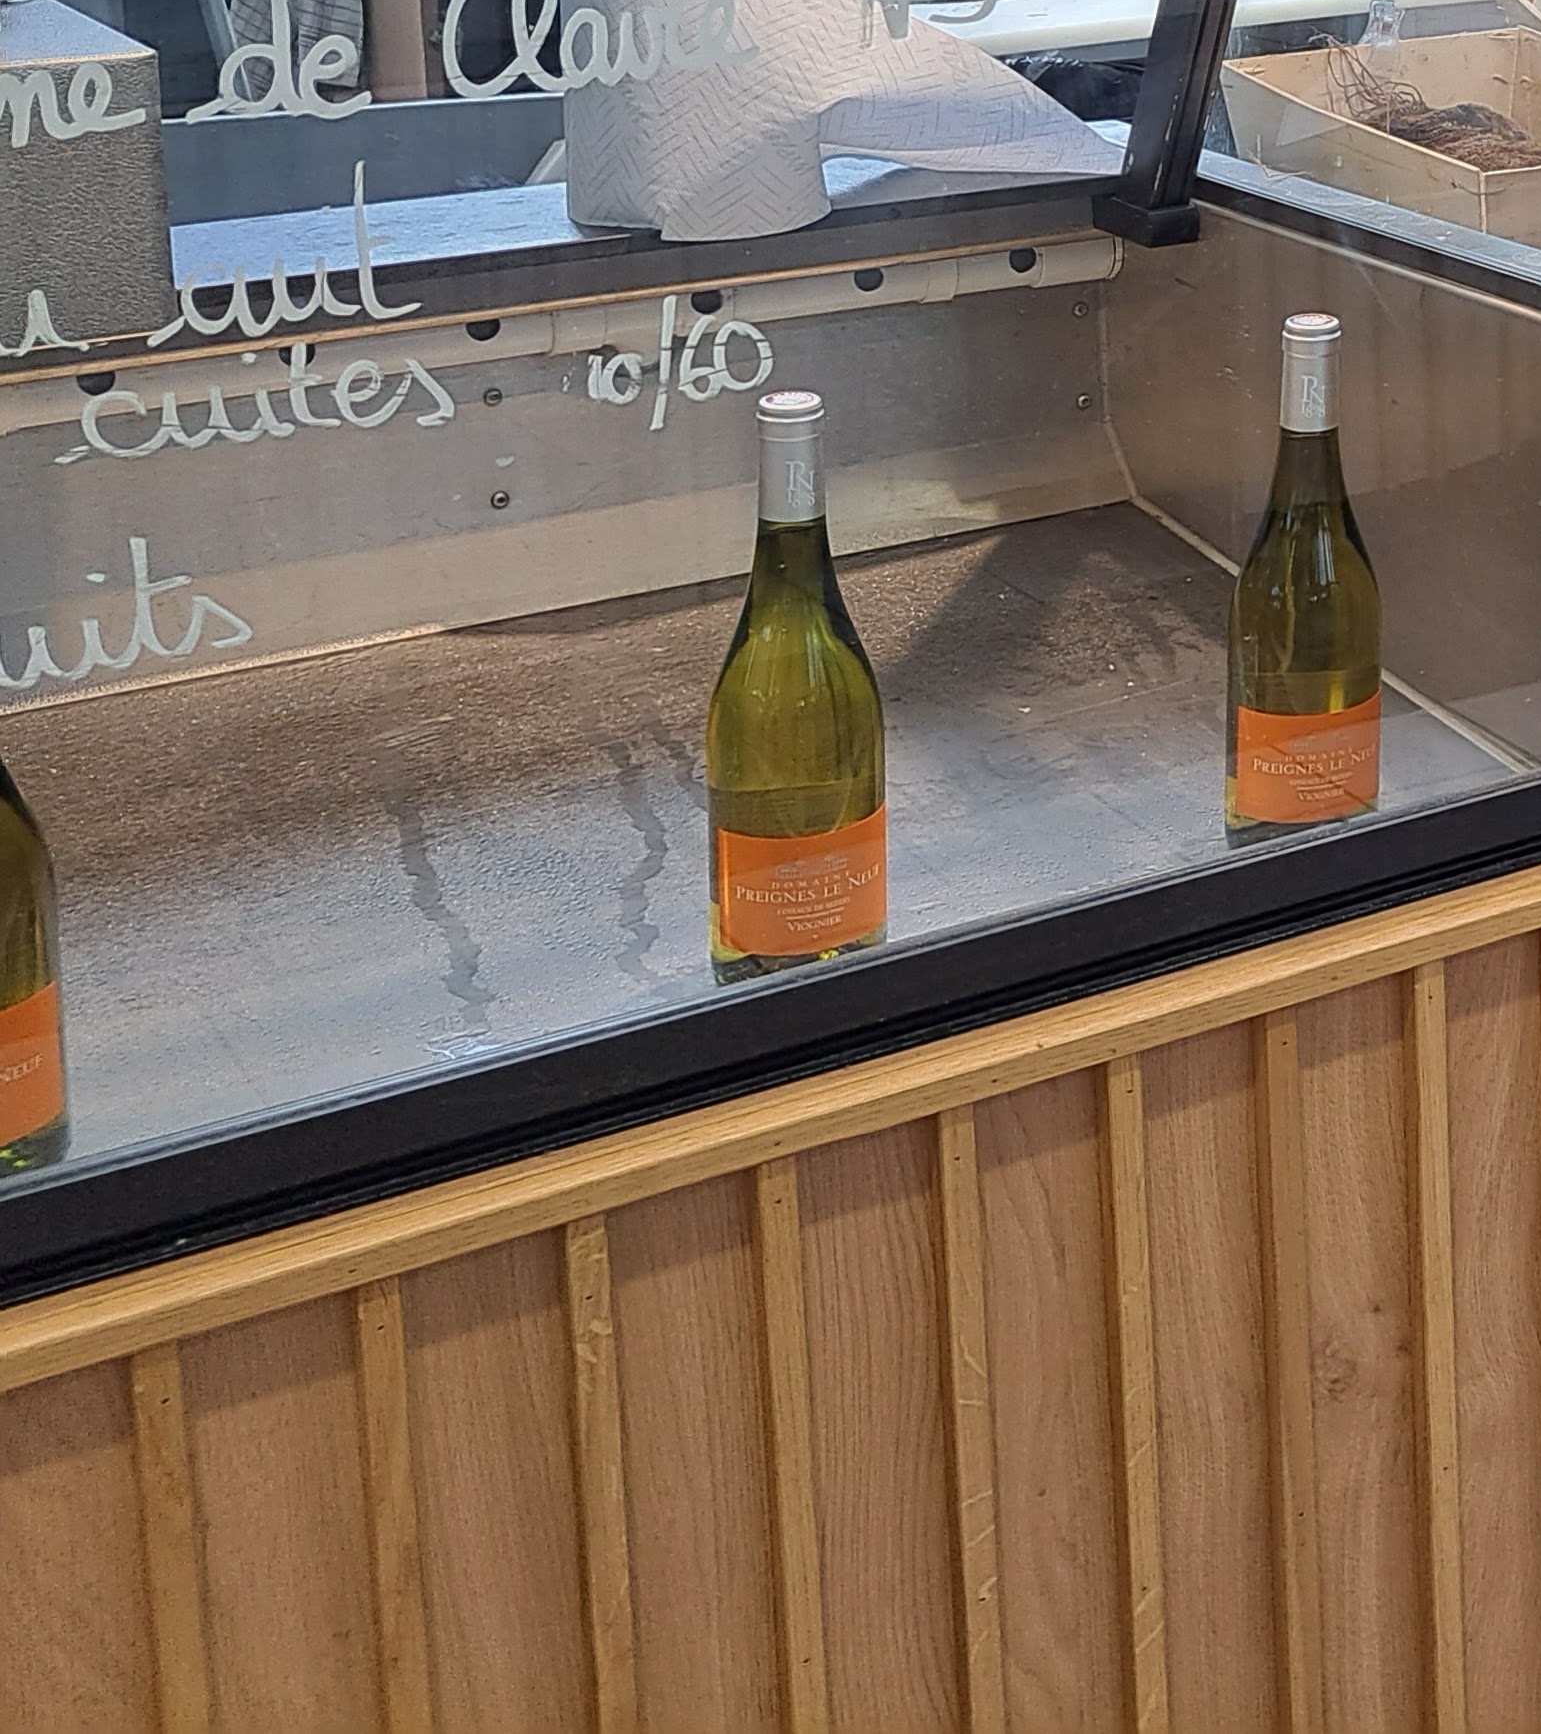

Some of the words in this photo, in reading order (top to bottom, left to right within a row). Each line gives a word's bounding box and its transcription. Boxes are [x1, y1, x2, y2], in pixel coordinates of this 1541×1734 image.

[1252, 756, 1324, 776] PREIGNES
[735, 884, 816, 904] PREIGNES
[823, 883, 842, 899] LE
[786, 916, 843, 933] VIOGNIER
